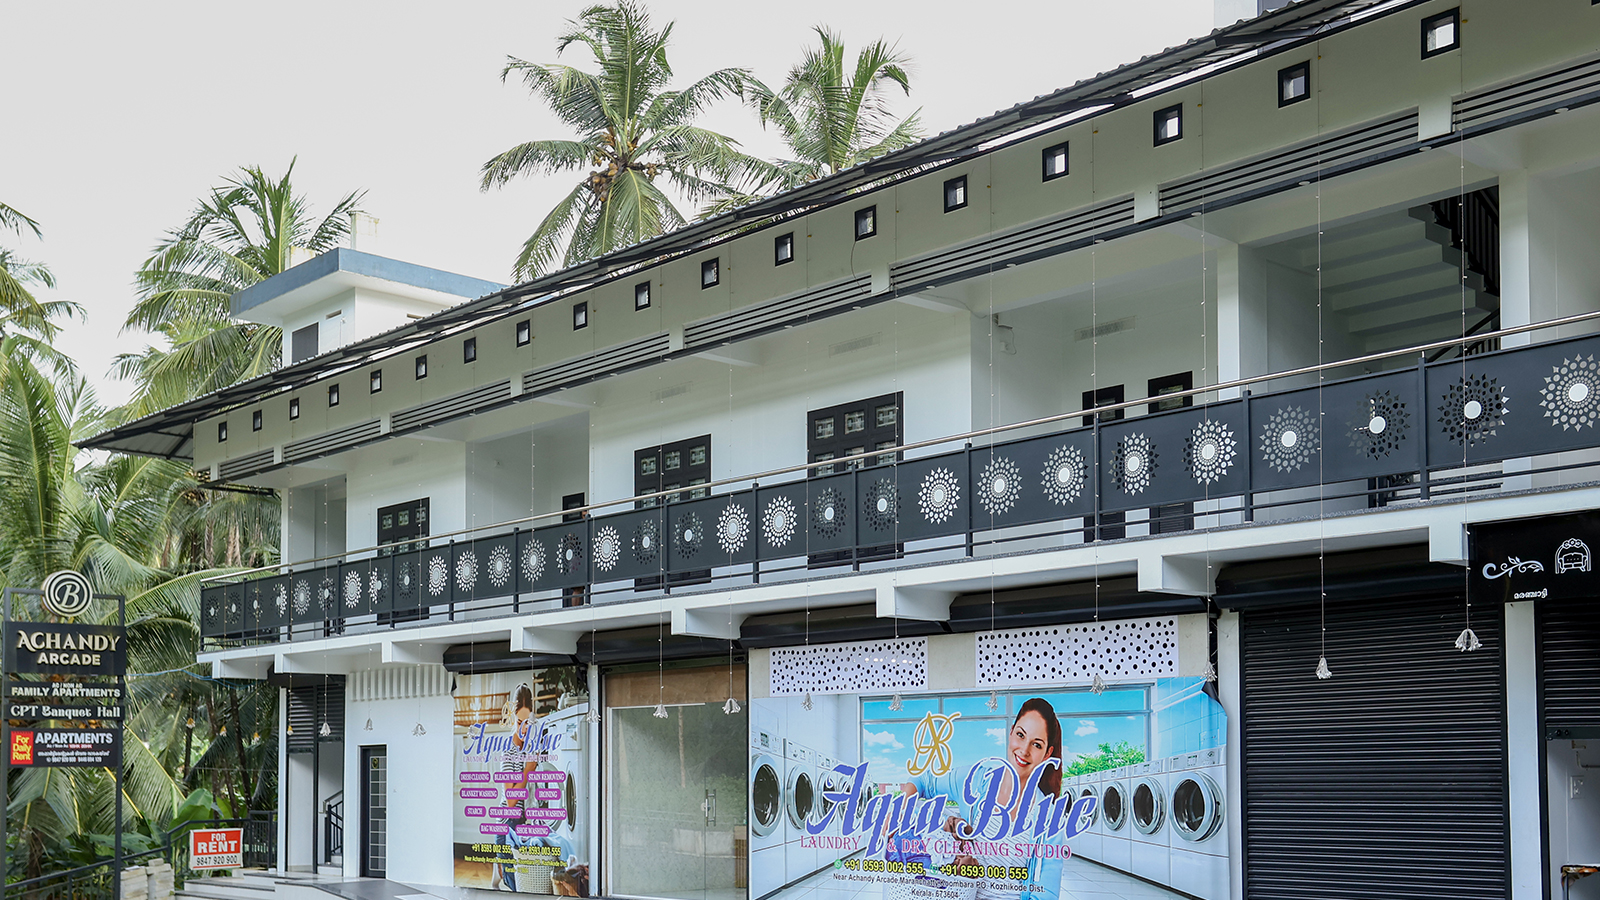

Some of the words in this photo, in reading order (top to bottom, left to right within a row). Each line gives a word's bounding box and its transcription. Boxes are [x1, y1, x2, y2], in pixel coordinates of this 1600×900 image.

[55, 580, 80, 608] B
[16, 630, 120, 652] ACHANDY
[37, 652, 101, 666] ARCADE
[11, 686, 49, 697] FAMILY
[52, 687, 120, 698] APARTMENTS
[41, 705, 92, 719] Banquet
[97, 706, 120, 718] Hall
[16, 735, 30, 744] For
[34, 732, 113, 744] APARTMENTS
[463, 721, 513, 763] Aqua
[518, 719, 563, 754] Blue
[13, 743, 32, 754] Daily
[13, 752, 31, 761] Rent
[511, 773, 523, 781] WASH
[528, 773, 541, 781] STAIN
[542, 773, 565, 781] REMOVING
[461, 790, 478, 798] BLANKET
[479, 790, 498, 798] WASHING
[506, 790, 527, 798] COMFORT
[538, 790, 558, 799] IRONING
[467, 807, 483, 815] STARCH
[489, 808, 503, 816] STEAM
[805, 761, 948, 858] Aqua
[957, 756, 1098, 842] Blue
[526, 809, 545, 817] CURTAIN
[546, 810, 566, 818] WASHING
[480, 824, 488, 832] BAG
[490, 825, 508, 833] WASHING
[529, 827, 549, 836] WASHING
[211, 833, 226, 842] FOR
[197, 840, 238, 853] RENT
[800, 835, 862, 851] LAUNDRY
[887, 839, 897, 852] &
[901, 839, 928, 854] DRY
[934, 840, 1010, 857] CLEANING
[1014, 843, 1072, 860] STUDIO
[196, 856, 211, 866] 9847
[213, 855, 225, 865] 920
[226, 855, 238, 864] 900
[844, 859, 860, 871] +91
[862, 860, 885, 872] 8593
[886, 861, 904, 873] 002
[906, 861, 926, 876] 555,
[940, 864, 957, 876] +91
[960, 865, 985, 878] 8593
[987, 866, 1007, 879] 003
[1009, 867, 1029, 880] 555
[849, 874, 875, 884] Achandy
[991, 883, 1027, 892] Kozhikode
[1029, 884, 1045, 893] Dist.
